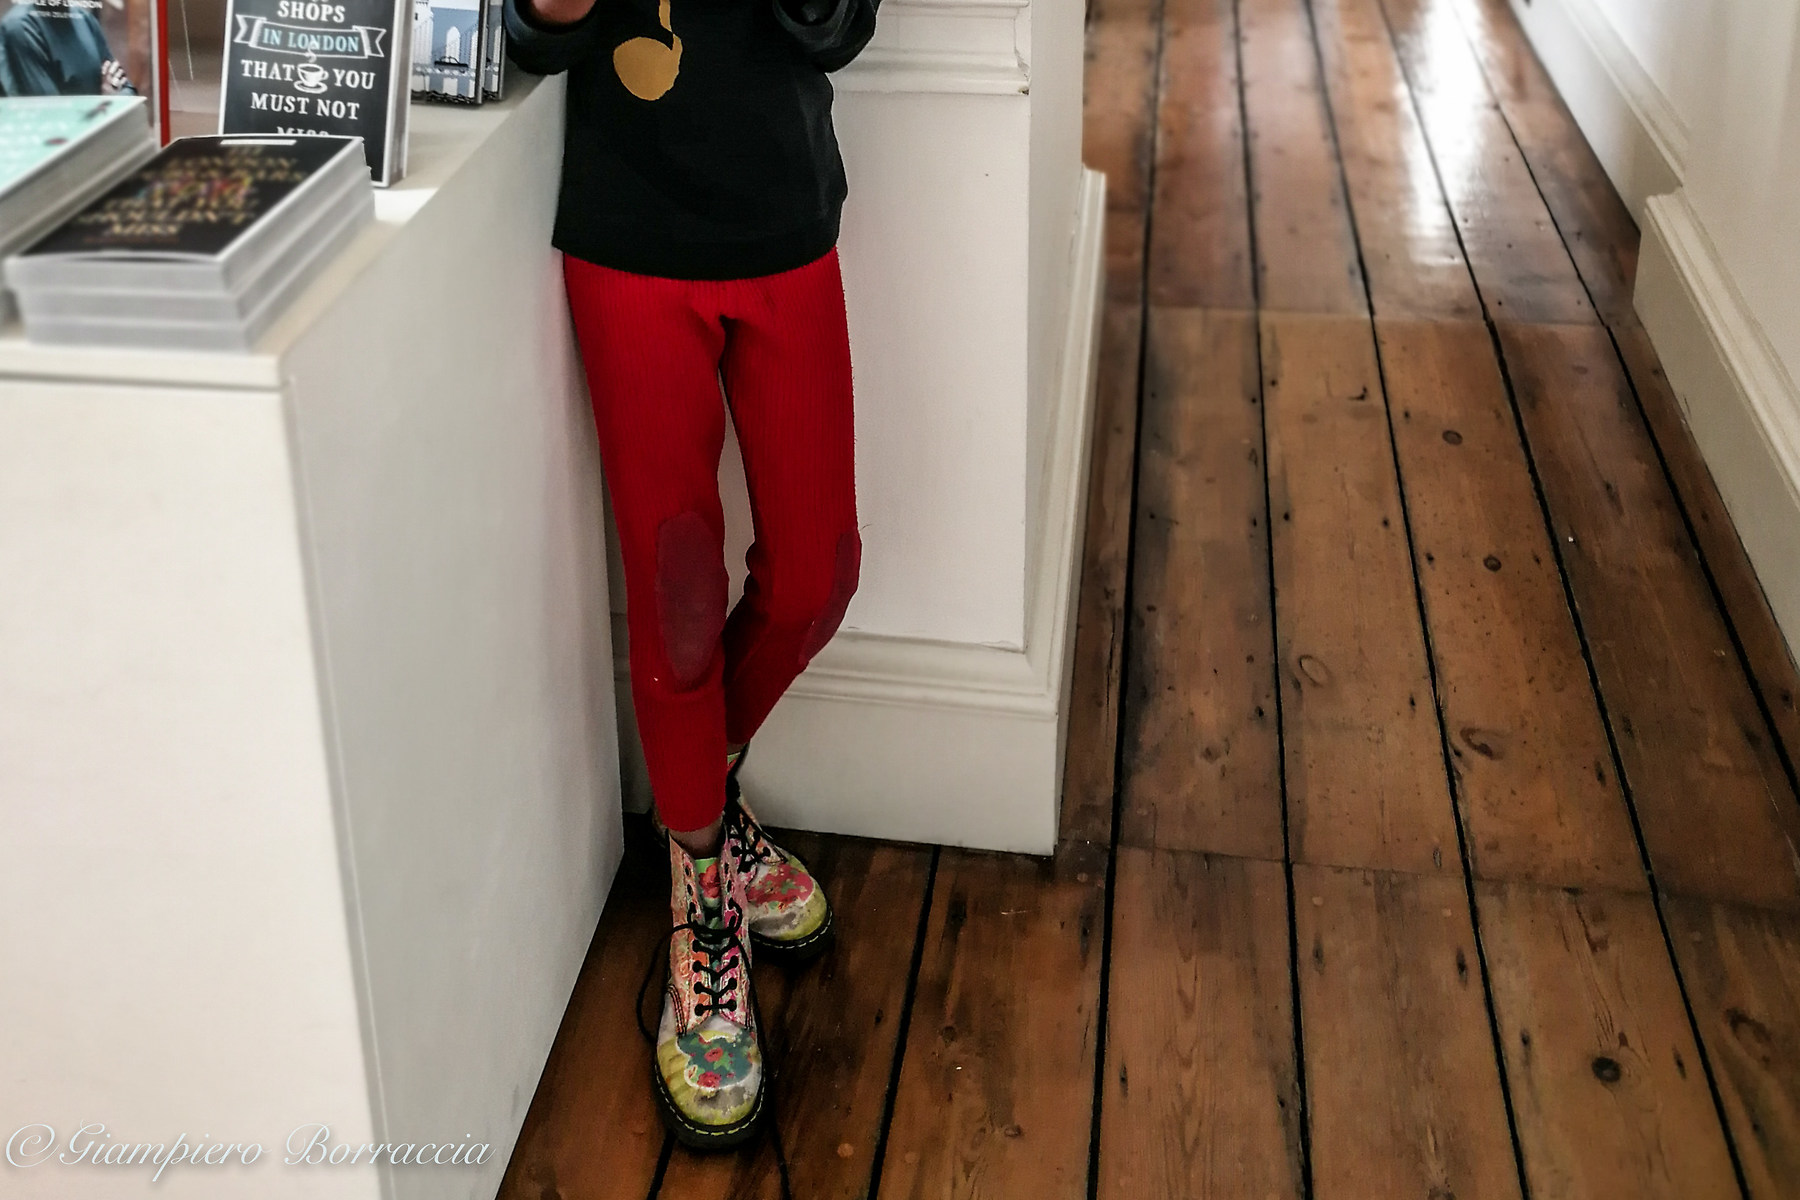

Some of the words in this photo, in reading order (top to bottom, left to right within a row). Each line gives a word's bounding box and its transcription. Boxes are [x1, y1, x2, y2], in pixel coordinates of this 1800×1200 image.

[277, 0, 346, 23] SHOPS
[262, 28, 281, 46] IN
[288, 31, 360, 52] LONDON
[241, 59, 295, 82] THAT
[332, 68, 376, 90] YOU
[250, 92, 310, 115] MUST
[316, 98, 360, 120] NOT
